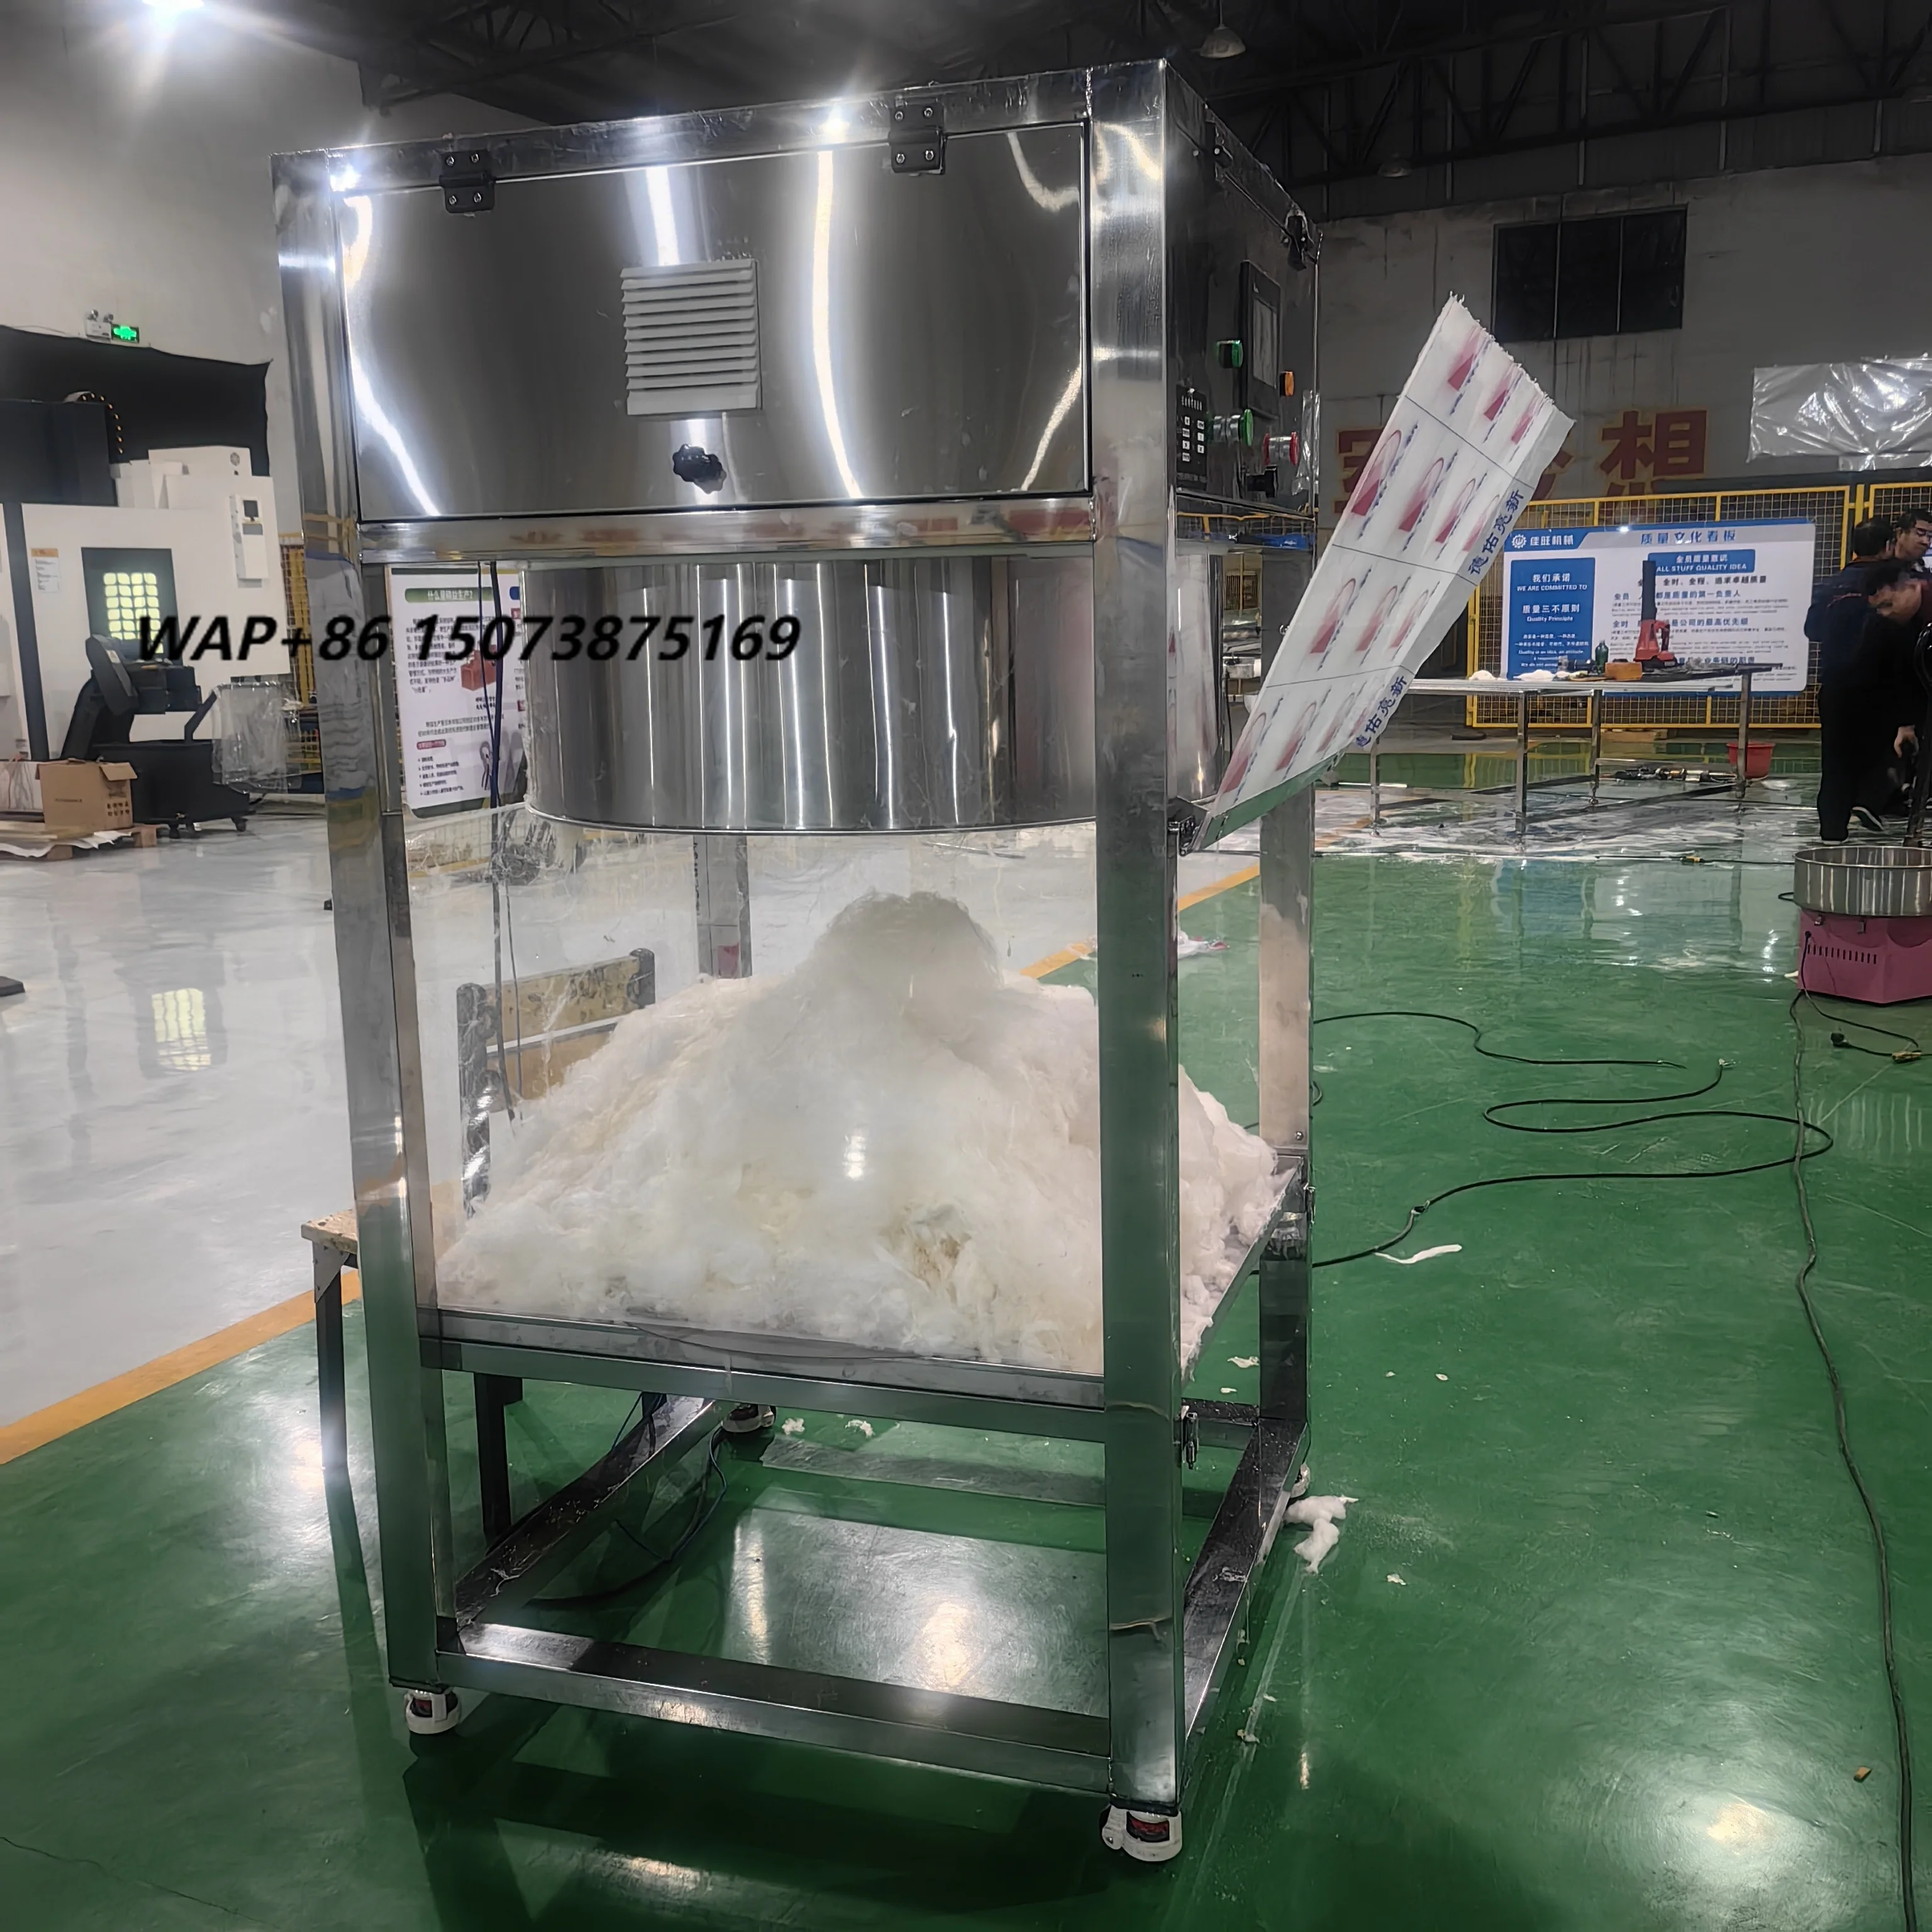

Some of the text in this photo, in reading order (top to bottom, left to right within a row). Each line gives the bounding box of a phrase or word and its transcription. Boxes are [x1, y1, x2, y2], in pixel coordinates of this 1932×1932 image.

[1468, 489, 1524, 574] 德佑亮新
[1530, 535, 1574, 546] 佳旺机械
[1641, 530, 1736, 545] 质量文化看板
[1676, 554, 1728, 564] 全员质量意识
[1696, 564, 1728, 572] QUALITY
[1533, 573, 1570, 583] 我们承诺
[1523, 604, 1580, 614] 质量三不原则
